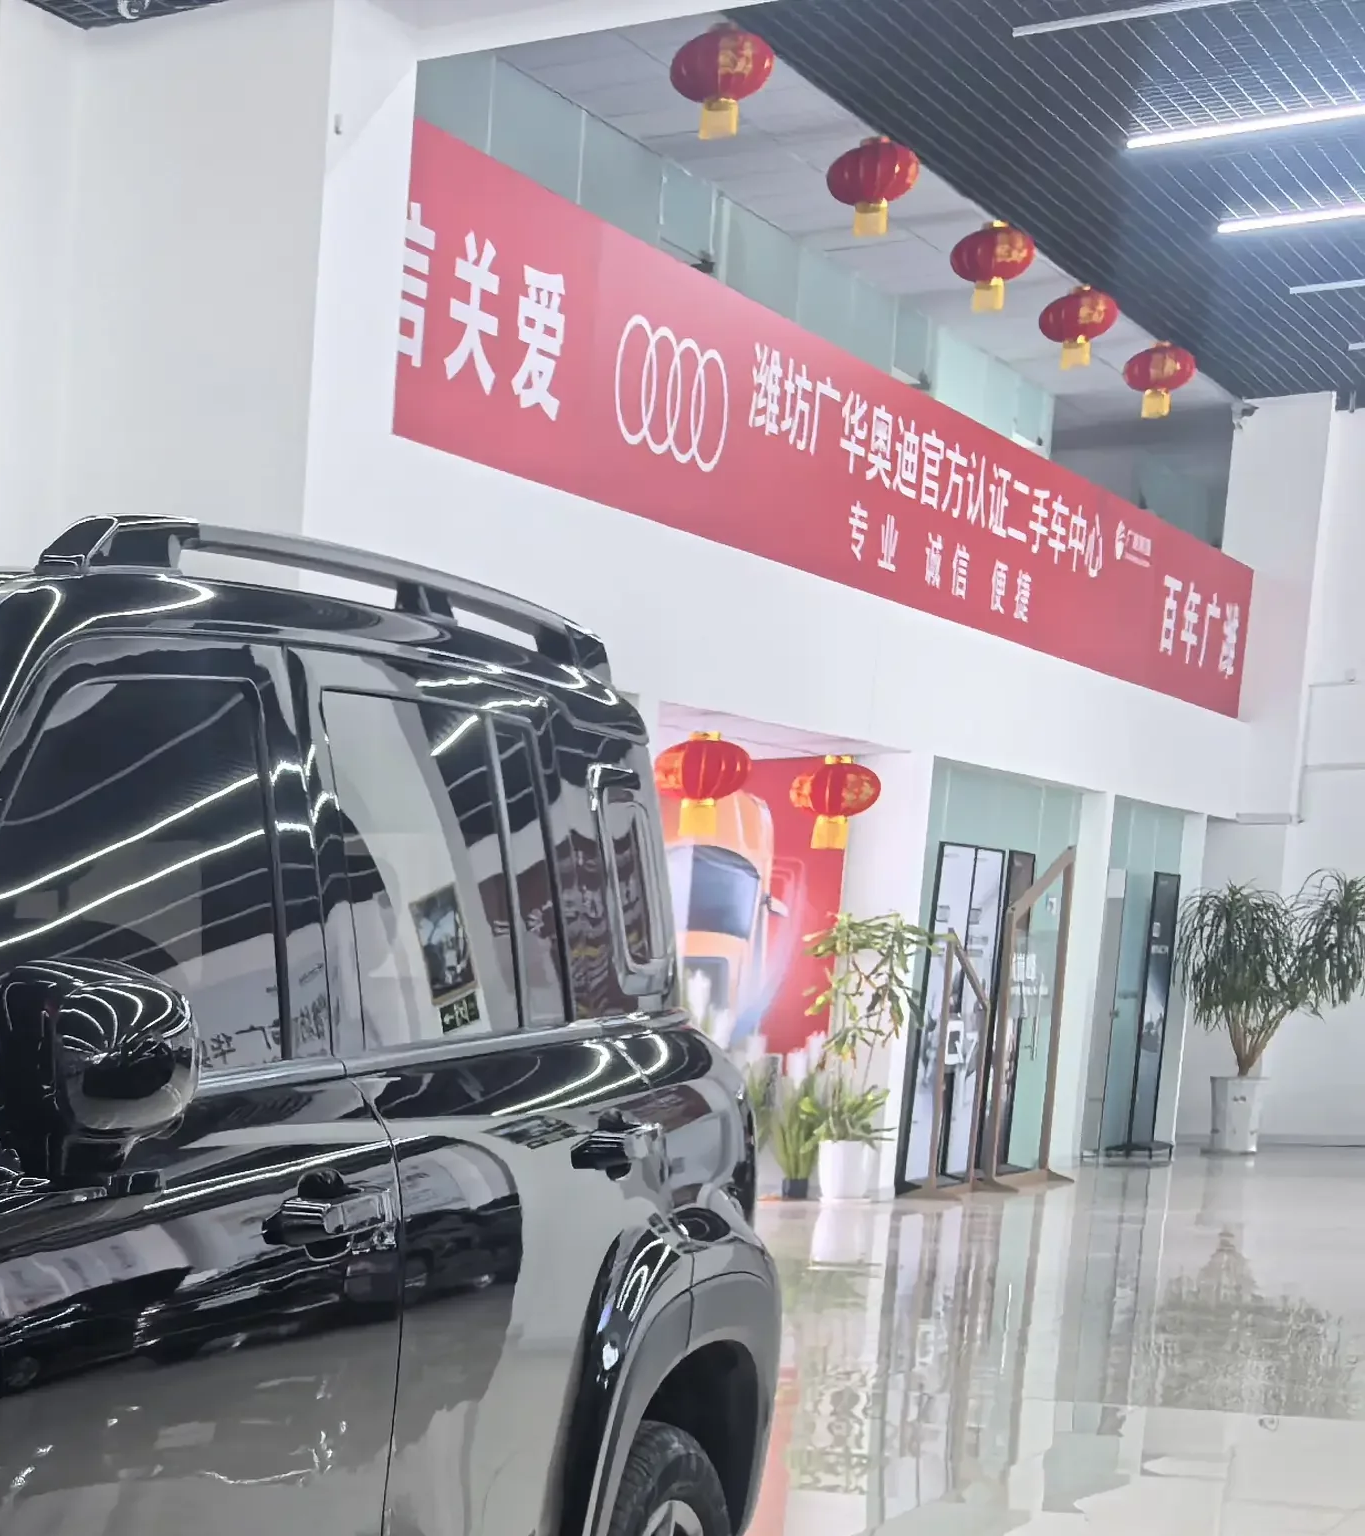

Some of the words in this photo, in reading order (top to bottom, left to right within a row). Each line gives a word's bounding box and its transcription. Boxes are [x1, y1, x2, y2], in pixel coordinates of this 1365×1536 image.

[748, 342, 1104, 579] 潍坊广华奥迪官方认证二手车中心
